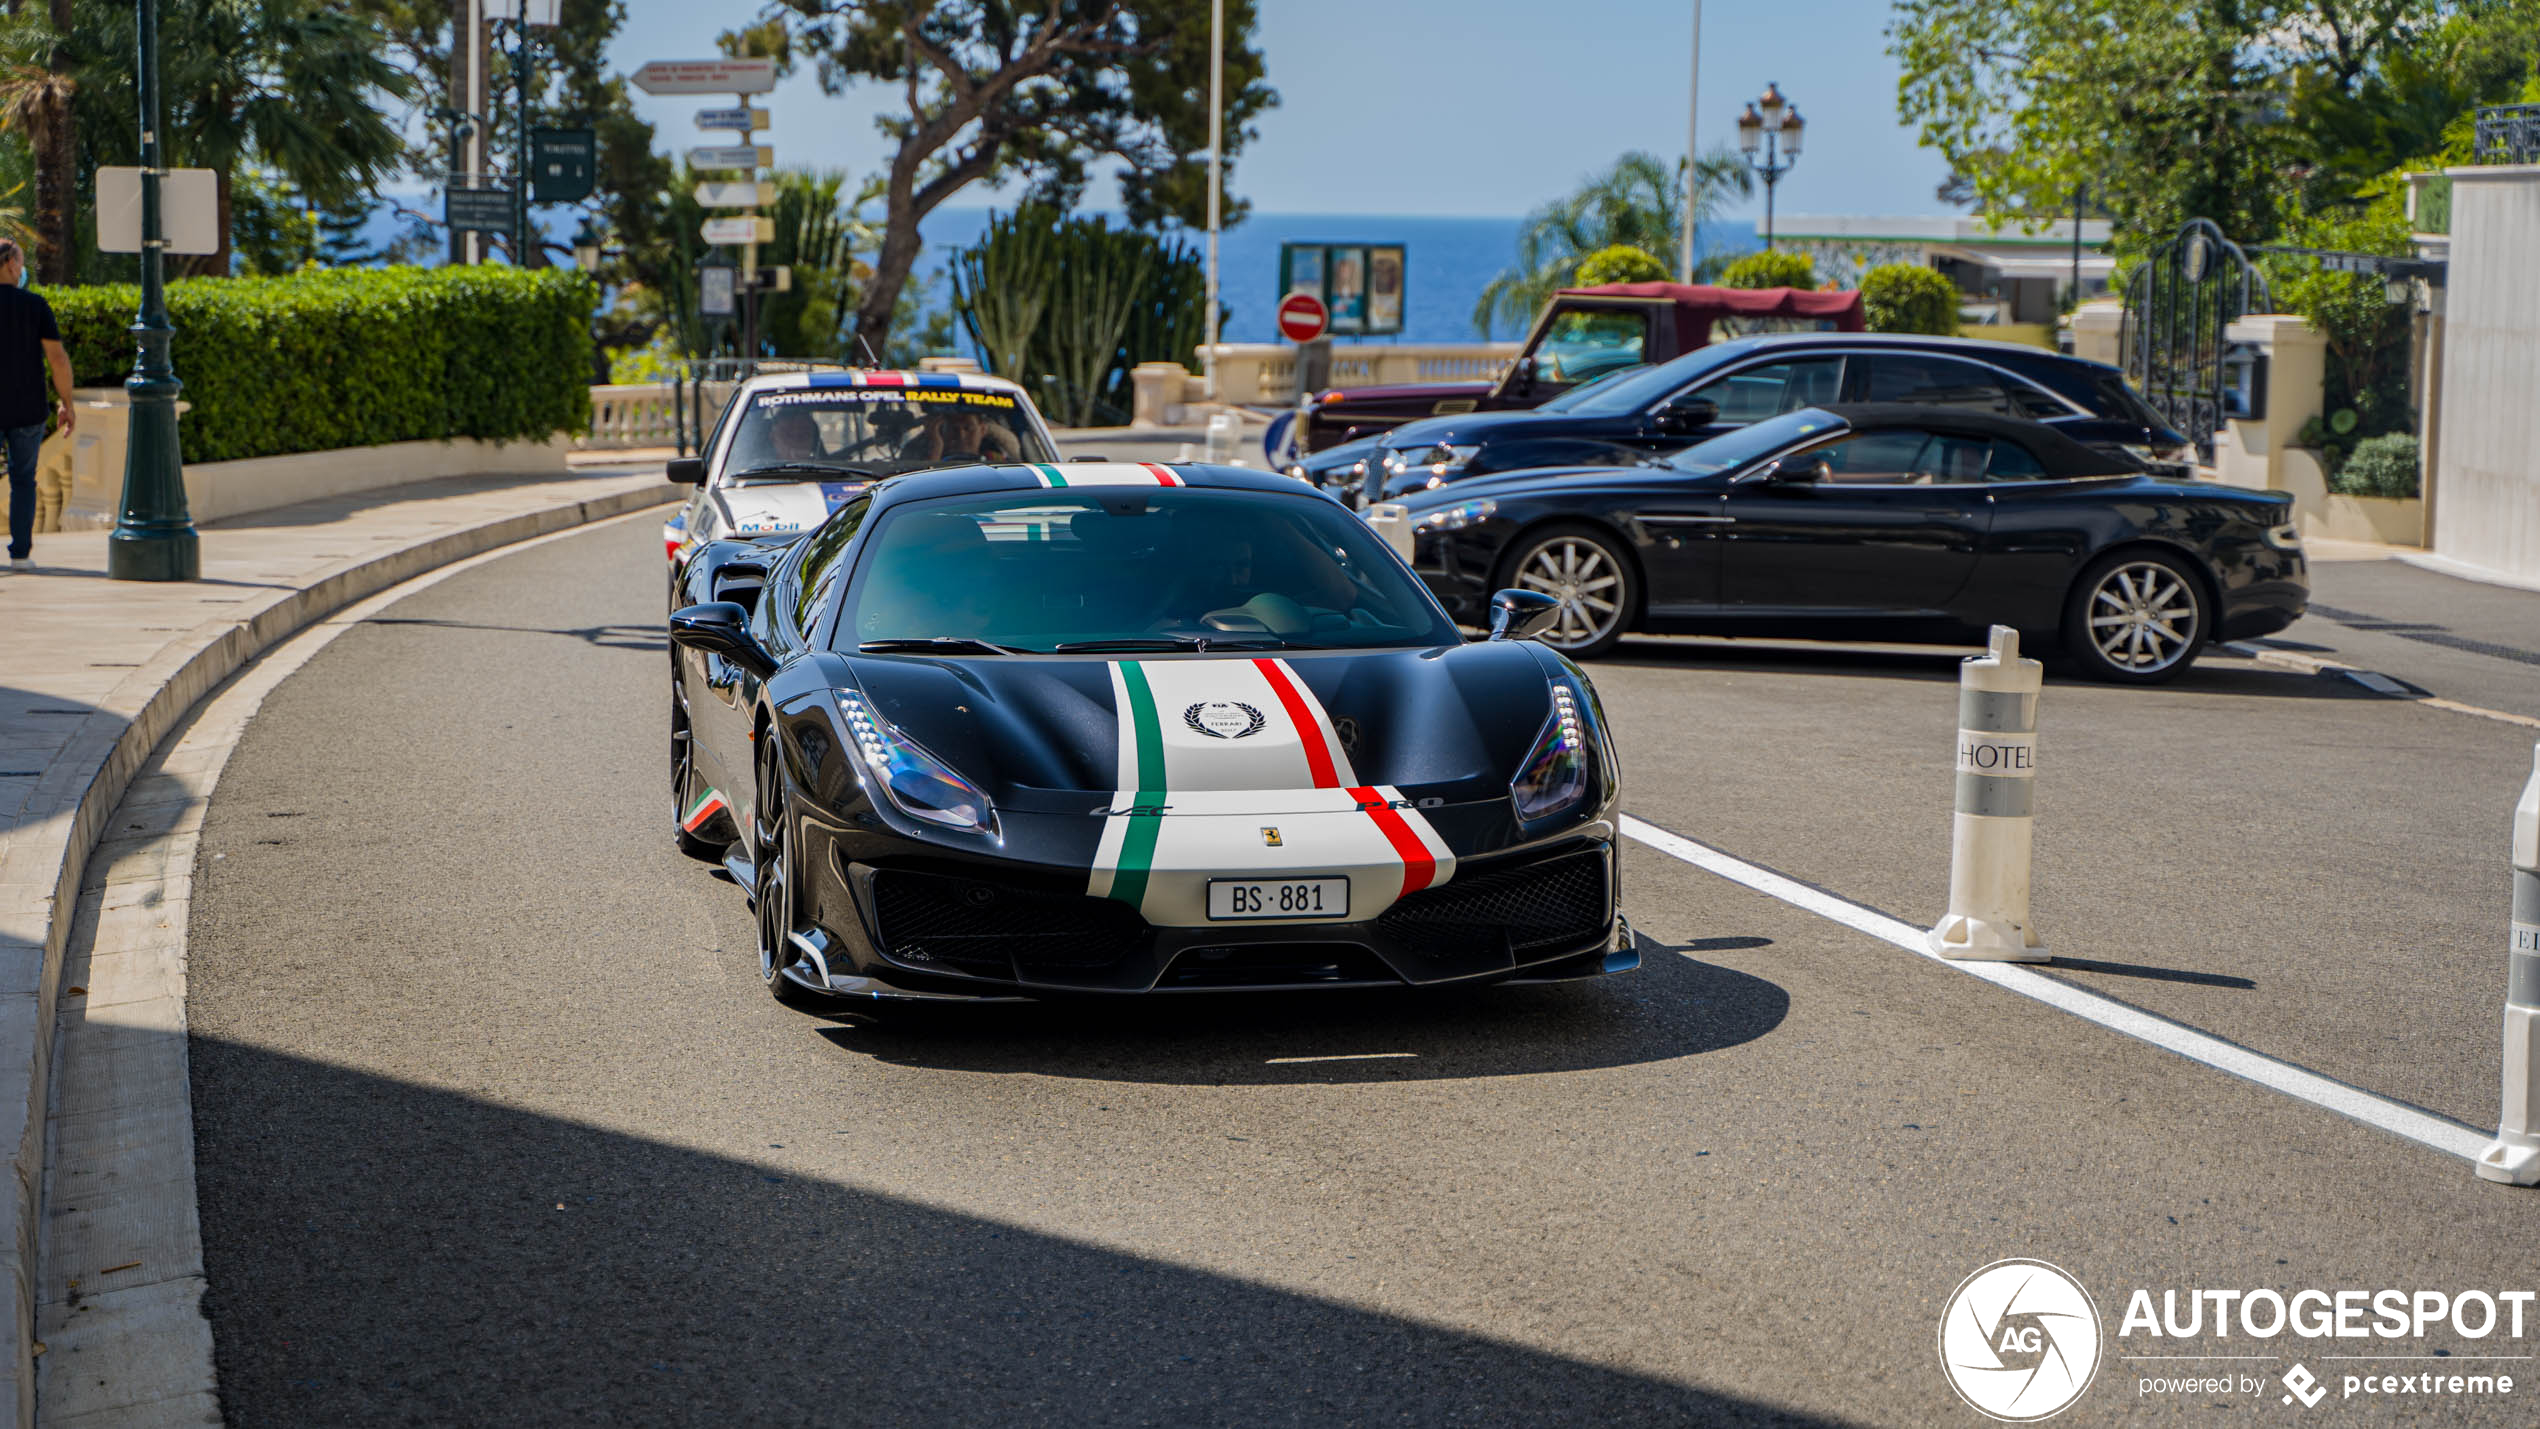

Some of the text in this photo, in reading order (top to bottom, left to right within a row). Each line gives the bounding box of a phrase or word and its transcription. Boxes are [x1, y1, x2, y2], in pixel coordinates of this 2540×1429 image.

[757, 391, 1015, 408] ROTHMANS OPEL RALLY TEAM
[741, 522, 799, 533] Mobil
[1961, 744, 2034, 769] HOTEL
[1355, 797, 1445, 812] PRO
